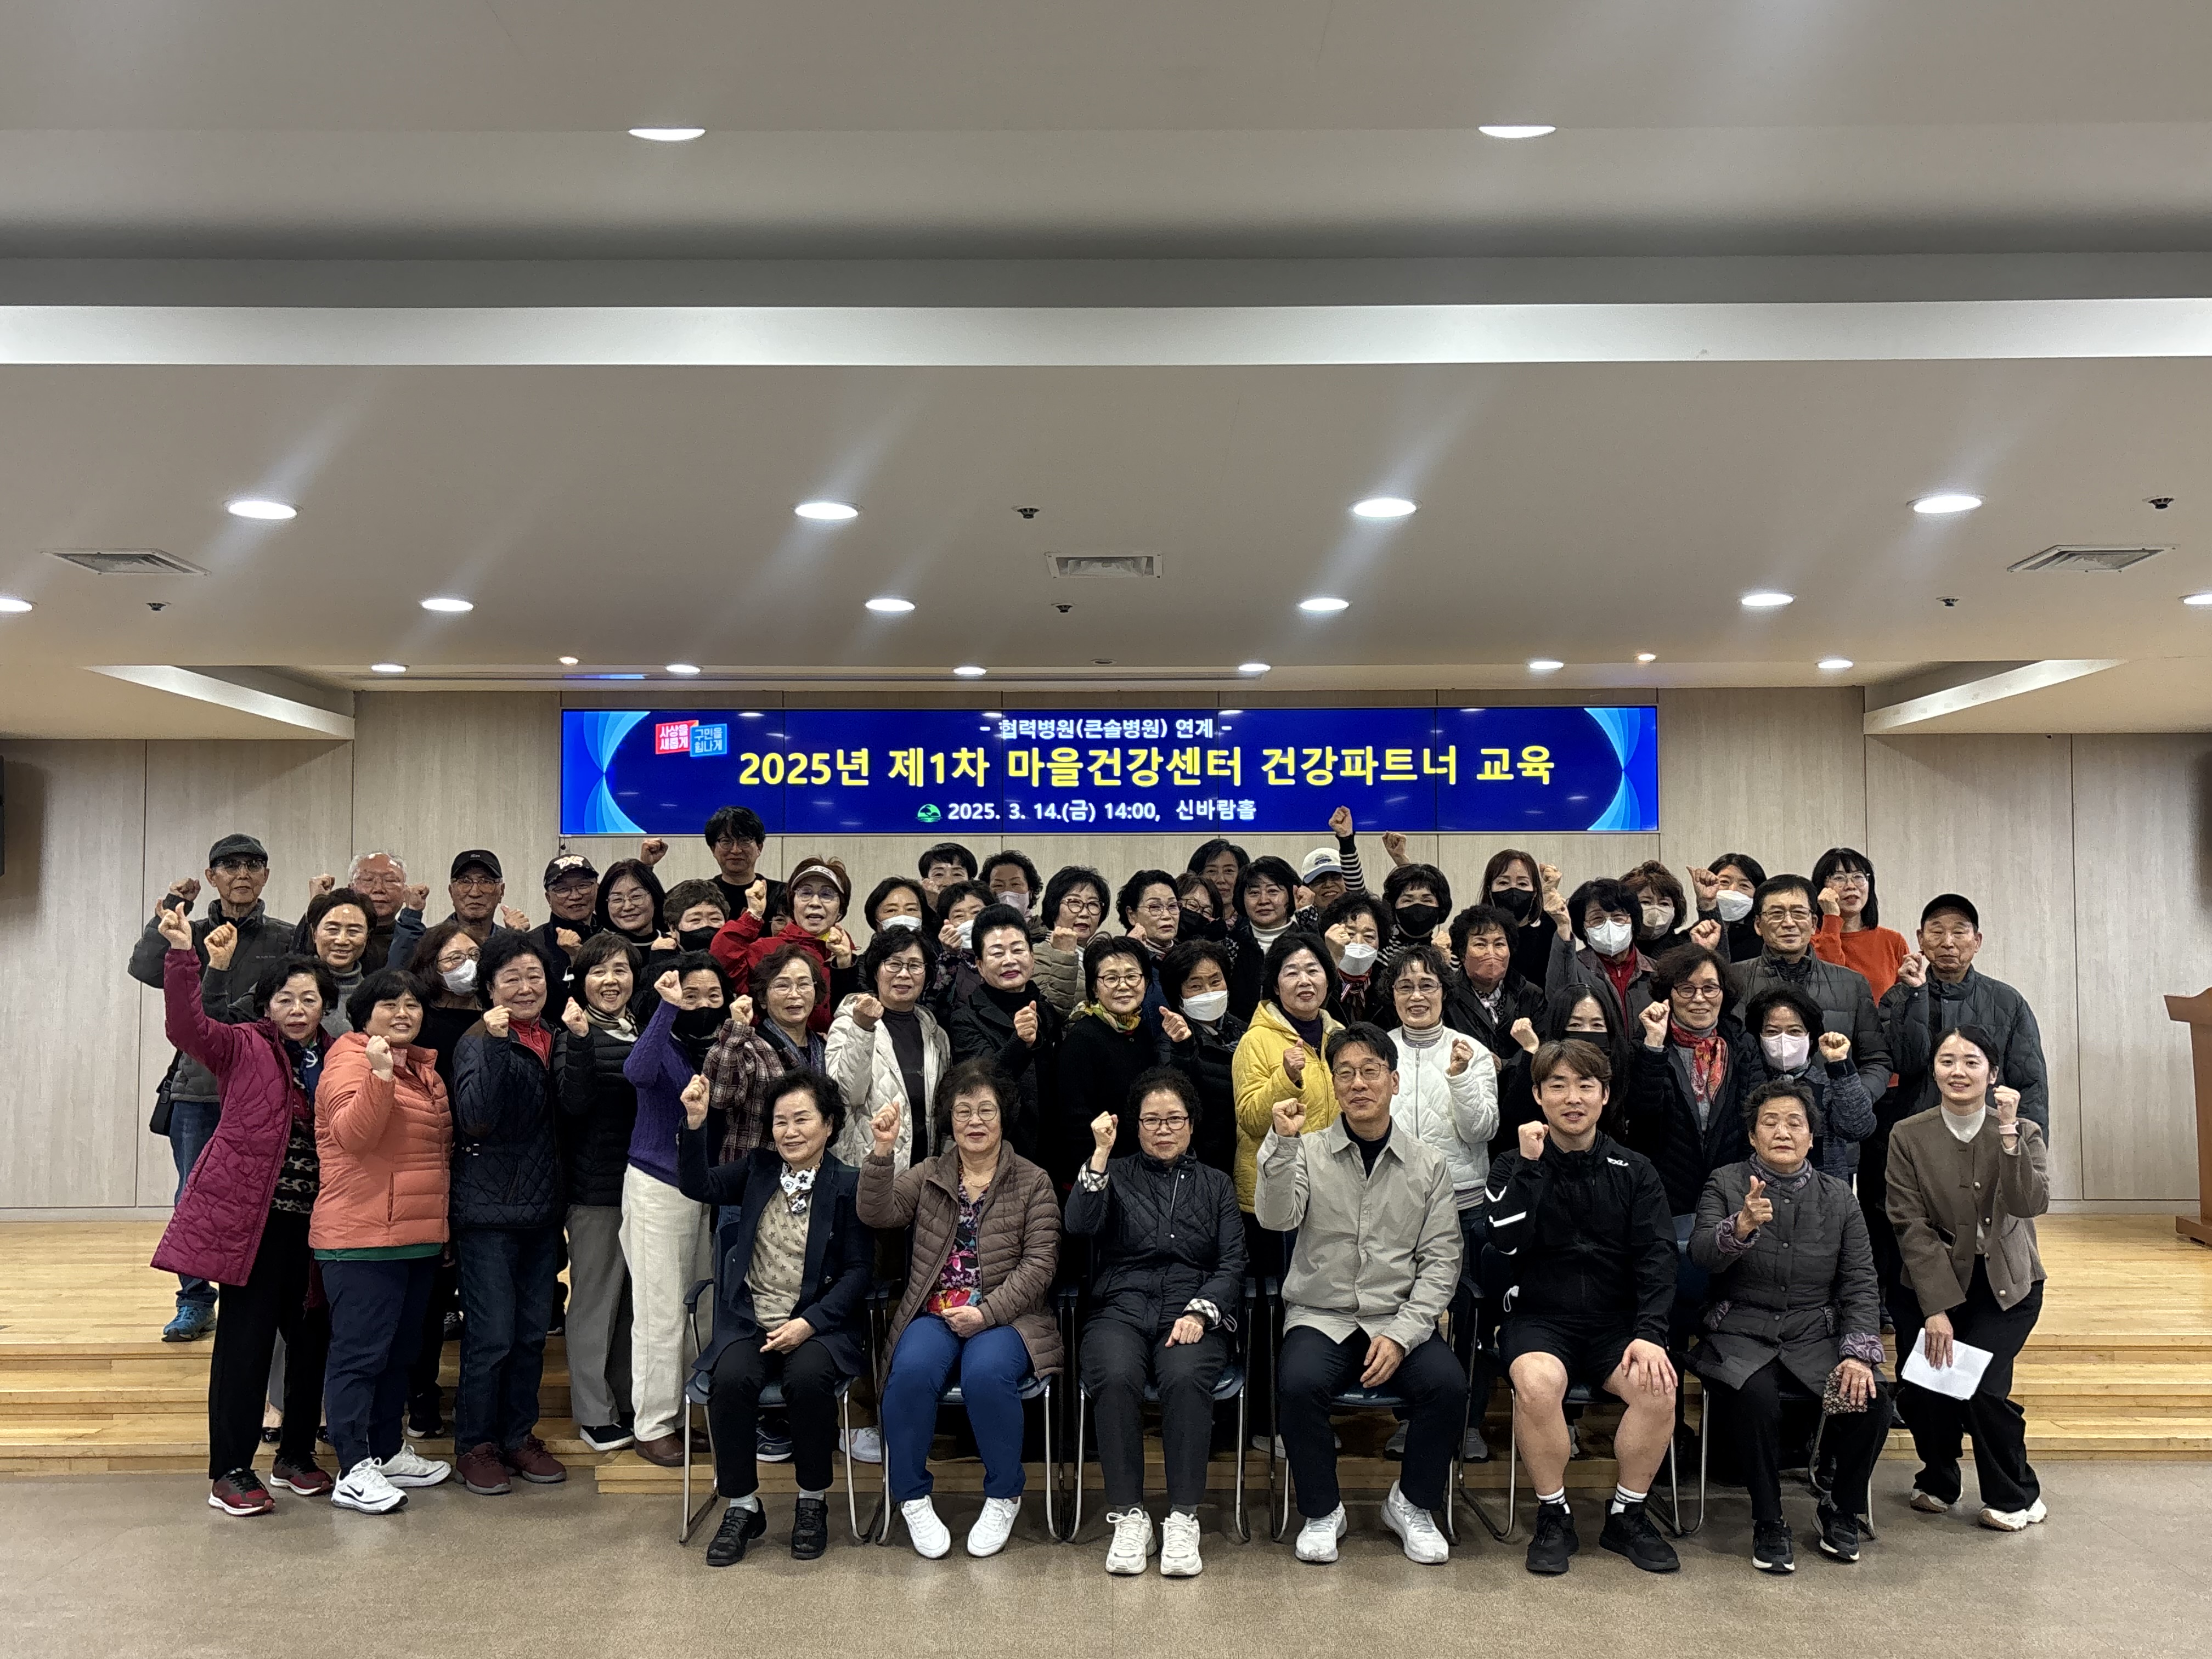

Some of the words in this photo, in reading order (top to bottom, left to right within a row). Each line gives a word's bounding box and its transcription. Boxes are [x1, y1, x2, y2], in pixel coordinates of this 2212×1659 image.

[659, 724, 688, 738] 사상을
[694, 727, 723, 741] 구민을
[1001, 718, 1167, 740] 협력병원(큰솔병원)
[1175, 718, 1213, 738] 연계
[739, 748, 869, 786] 2025년
[888, 747, 990, 787] 제1차
[1008, 747, 1241, 787] 마을건강센터
[1261, 745, 1457, 786] 건강파트너
[1476, 745, 1555, 785] 교육
[947, 803, 1001, 820] 2025.
[1009, 803, 1026, 820] 3.
[1034, 799, 1096, 823] 14.(금)
[1104, 802, 1161, 822] 14:00,
[1176, 799, 1257, 821] 신바람홀
